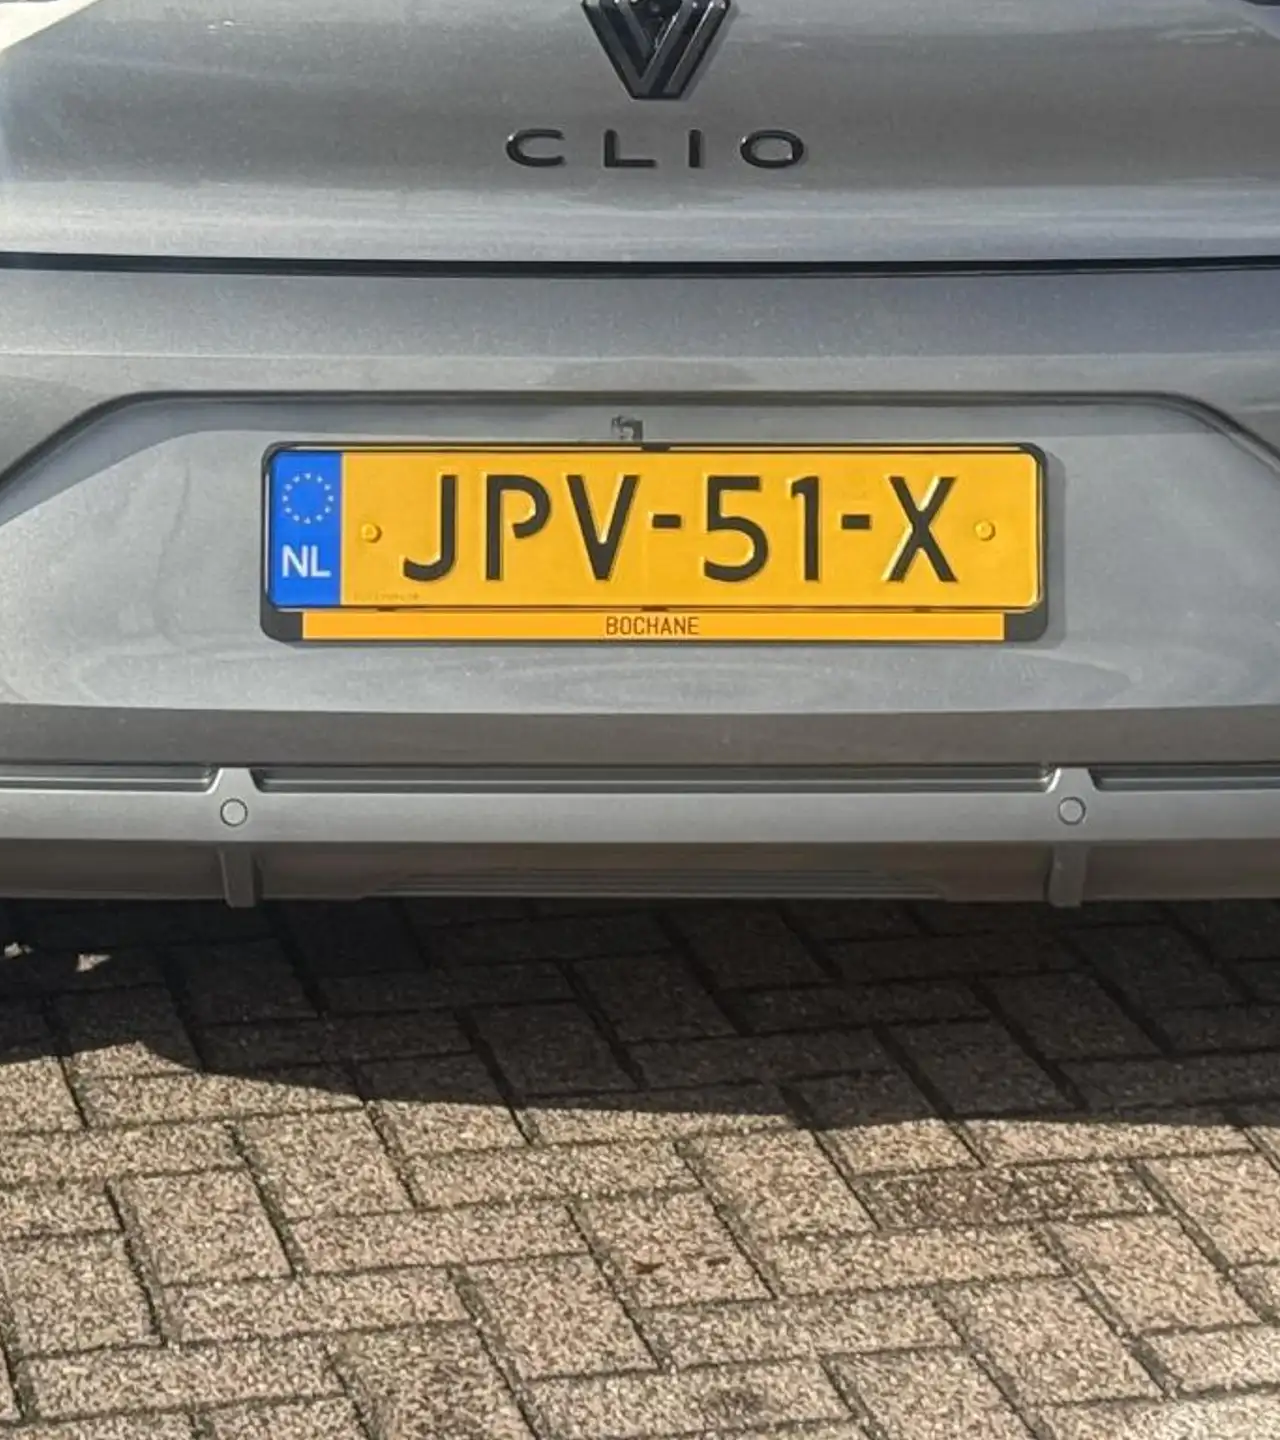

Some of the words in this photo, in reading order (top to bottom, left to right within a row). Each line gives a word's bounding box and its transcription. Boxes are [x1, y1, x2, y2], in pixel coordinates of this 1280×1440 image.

[505, 128, 805, 168] CLIO
[401, 473, 958, 582] JPV-51-X
[282, 544, 332, 578] NL
[606, 616, 700, 635] BOCHANE
